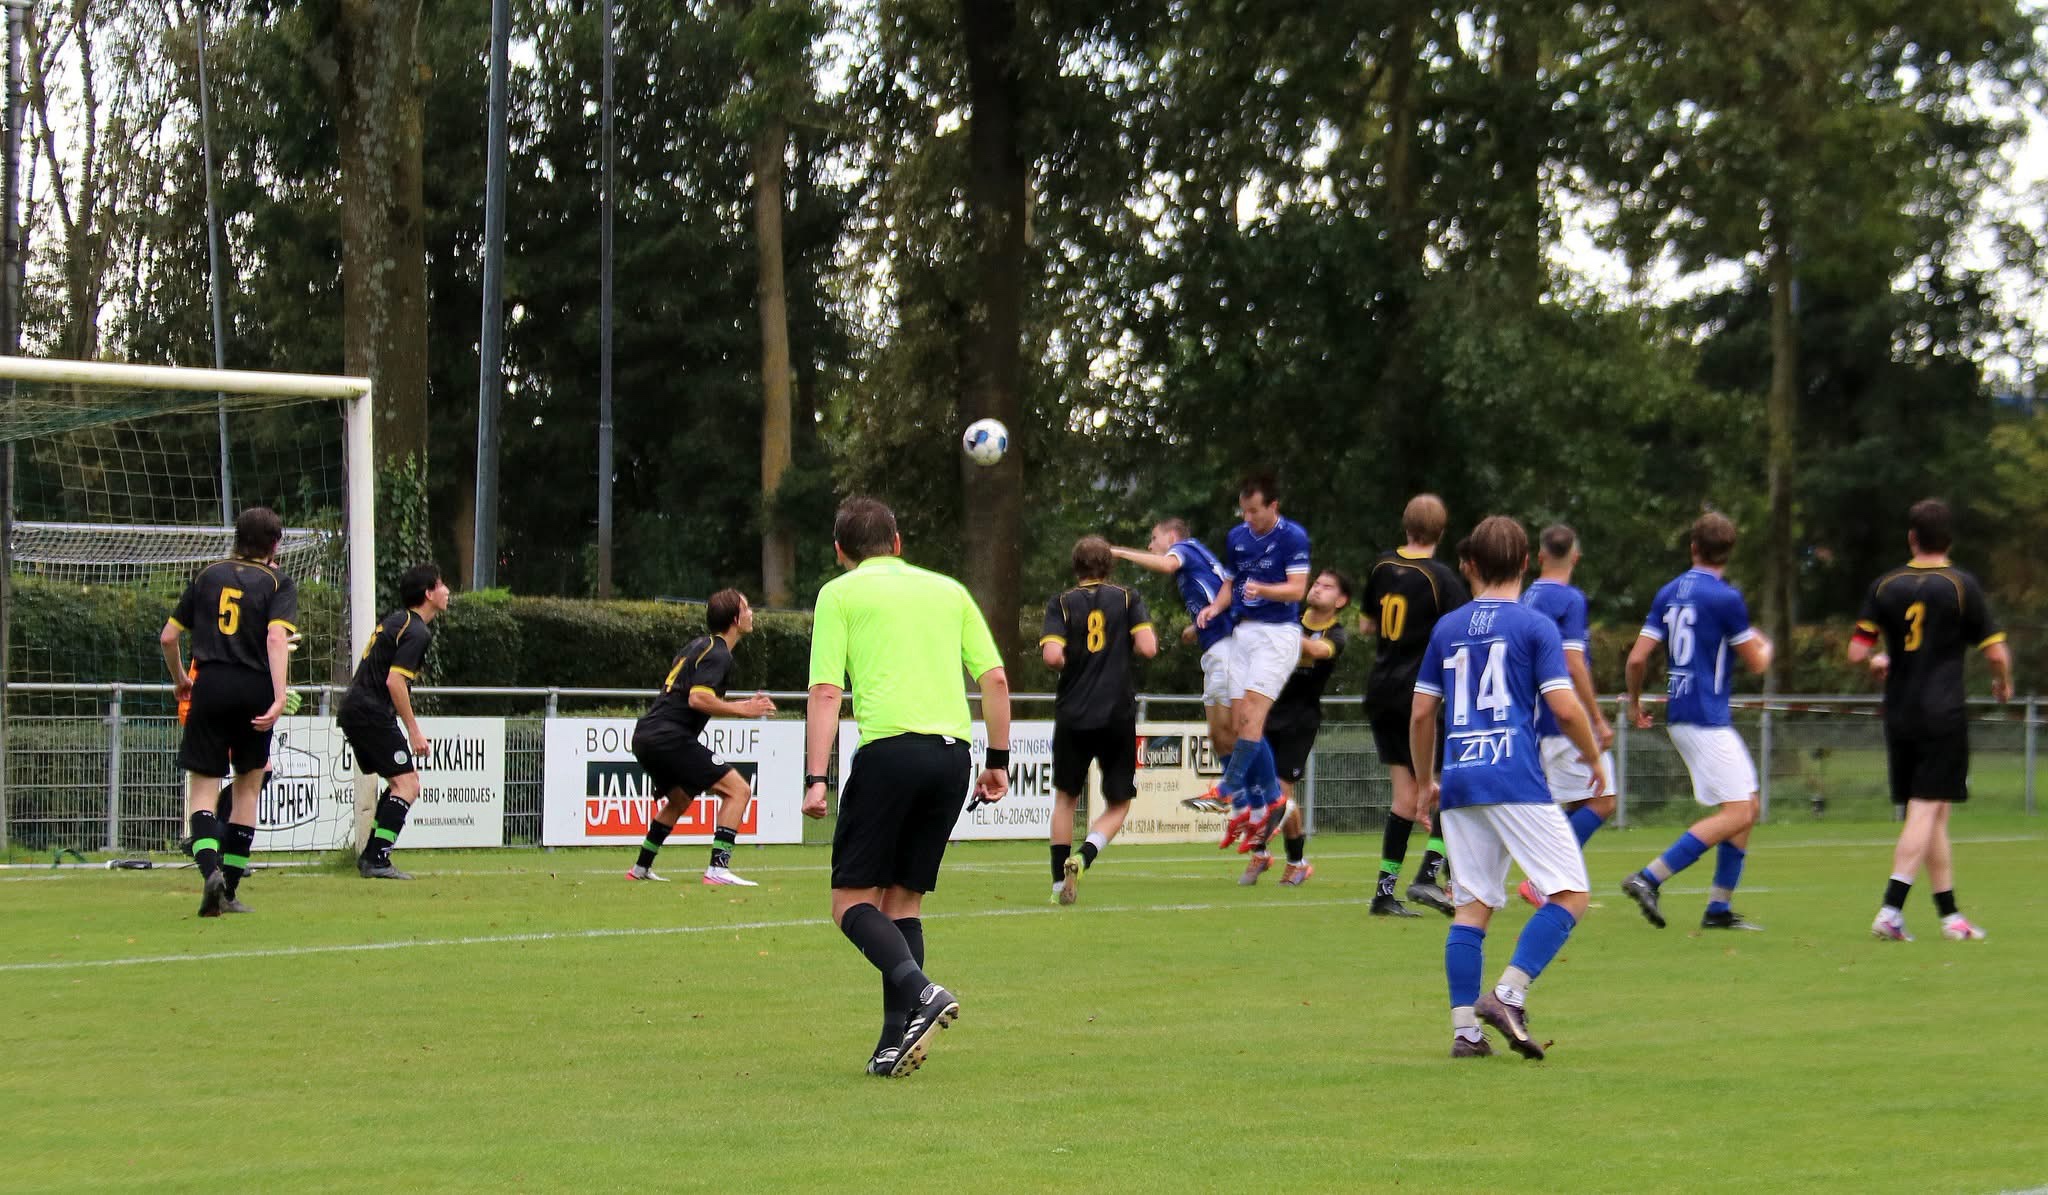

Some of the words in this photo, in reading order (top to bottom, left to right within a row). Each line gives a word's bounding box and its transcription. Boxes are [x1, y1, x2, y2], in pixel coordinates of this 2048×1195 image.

[218, 586, 244, 636] 5
[1087, 609, 1106, 653] 8
[1380, 593, 1406, 641] 10
[1904, 601, 1926, 652] 3
[1662, 605, 1698, 667] 16
[1443, 642, 1511, 726] 14
[422, 787, 440, 805] BBQ
[447, 787, 490, 804] BROODJES
[993, 807, 1051, 825] 06-20694319
[1156, 820, 1190, 833] Wormerveer
[1195, 819, 1220, 833] Telefoon
